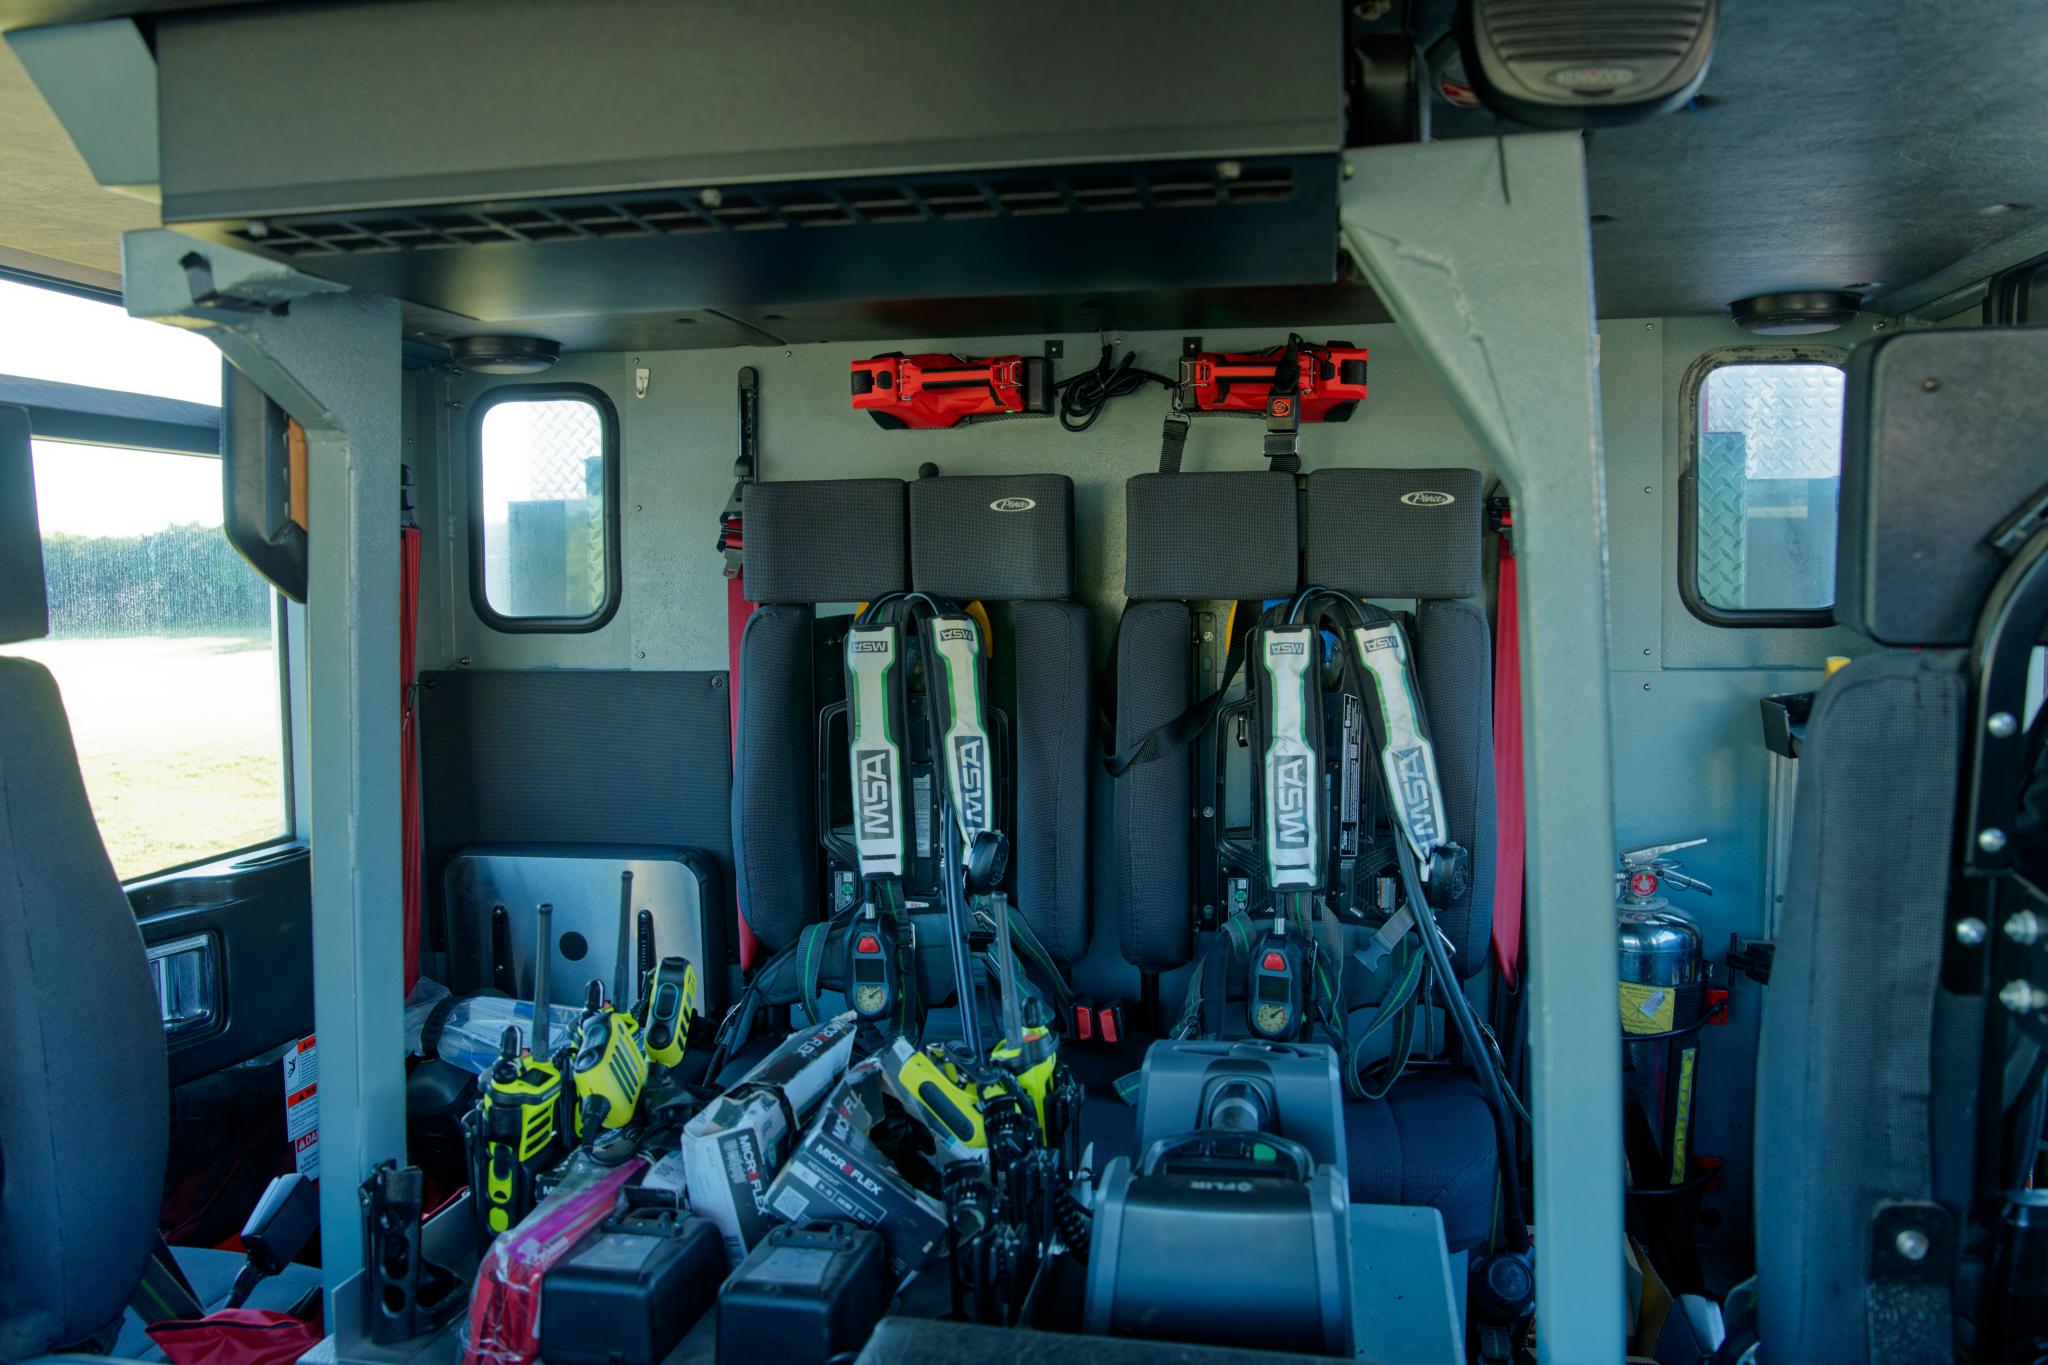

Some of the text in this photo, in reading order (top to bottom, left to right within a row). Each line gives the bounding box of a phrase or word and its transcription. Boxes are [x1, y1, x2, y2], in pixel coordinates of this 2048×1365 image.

[1556, 68, 1634, 85] KENWOOD
[853, 641, 887, 653] MSA
[942, 628, 974, 642] MSA
[1271, 643, 1304, 655] MSA
[1365, 636, 1399, 653] MSA
[861, 752, 890, 835] MSA
[960, 739, 984, 823] MSA
[1277, 758, 1307, 844] MSA
[1398, 749, 1435, 838] MSA
[739, 1136, 767, 1214] MICROFLEX
[814, 1143, 884, 1196] MICROFLEX
